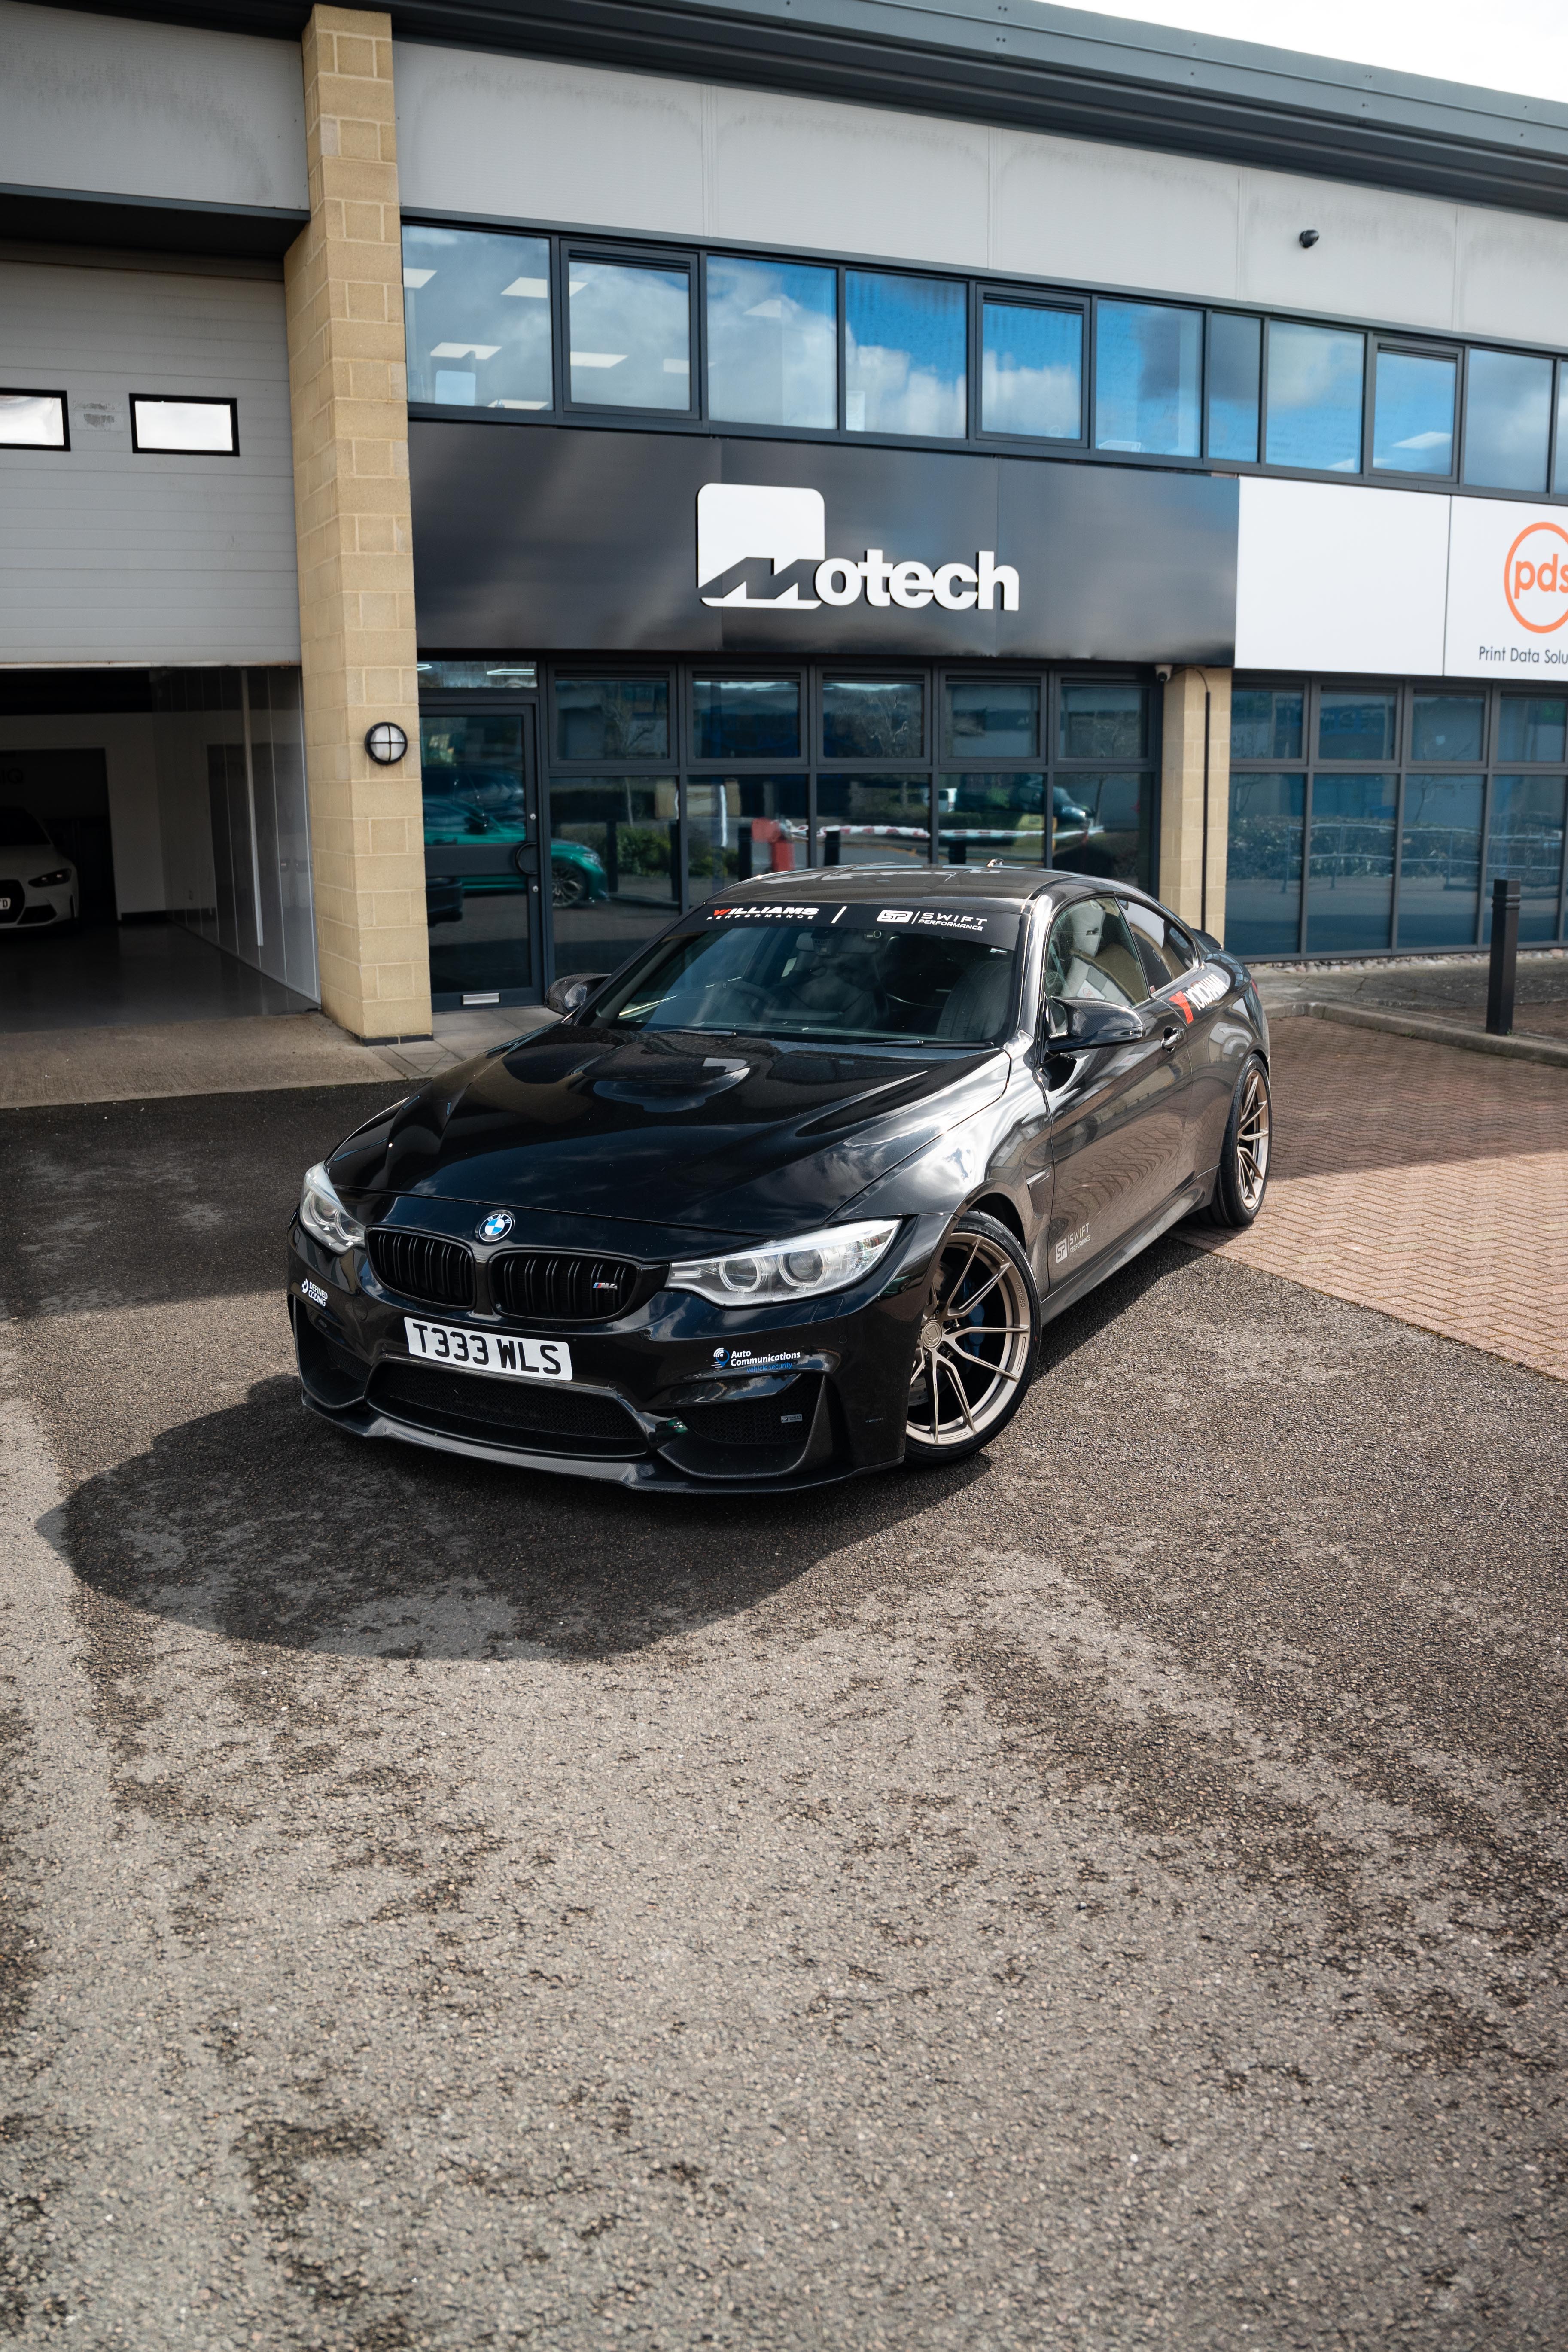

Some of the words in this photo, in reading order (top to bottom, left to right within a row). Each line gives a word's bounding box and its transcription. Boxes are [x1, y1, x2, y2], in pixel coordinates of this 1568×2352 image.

[1514, 553, 1568, 599] pds
[1479, 646, 1506, 662] Print
[1510, 648, 1540, 663] Data
[714, 907, 819, 916] WILLIAMS
[921, 912, 988, 925] SWIFT
[918, 919, 984, 931] PERFORMANCE
[487, 1214, 511, 1224] BMW
[1069, 1222, 1090, 1245] SWIFT
[1070, 1235, 1091, 1254] PERFORMANCE
[308, 1290, 326, 1306] CODING
[309, 1281, 328, 1299] DEFINED
[1014, 1281, 1026, 1308] FORGED
[412, 1323, 489, 1365] T333
[496, 1339, 561, 1375] WLS
[731, 1352, 801, 1366] Communications
[769, 1362, 792, 1370] security
